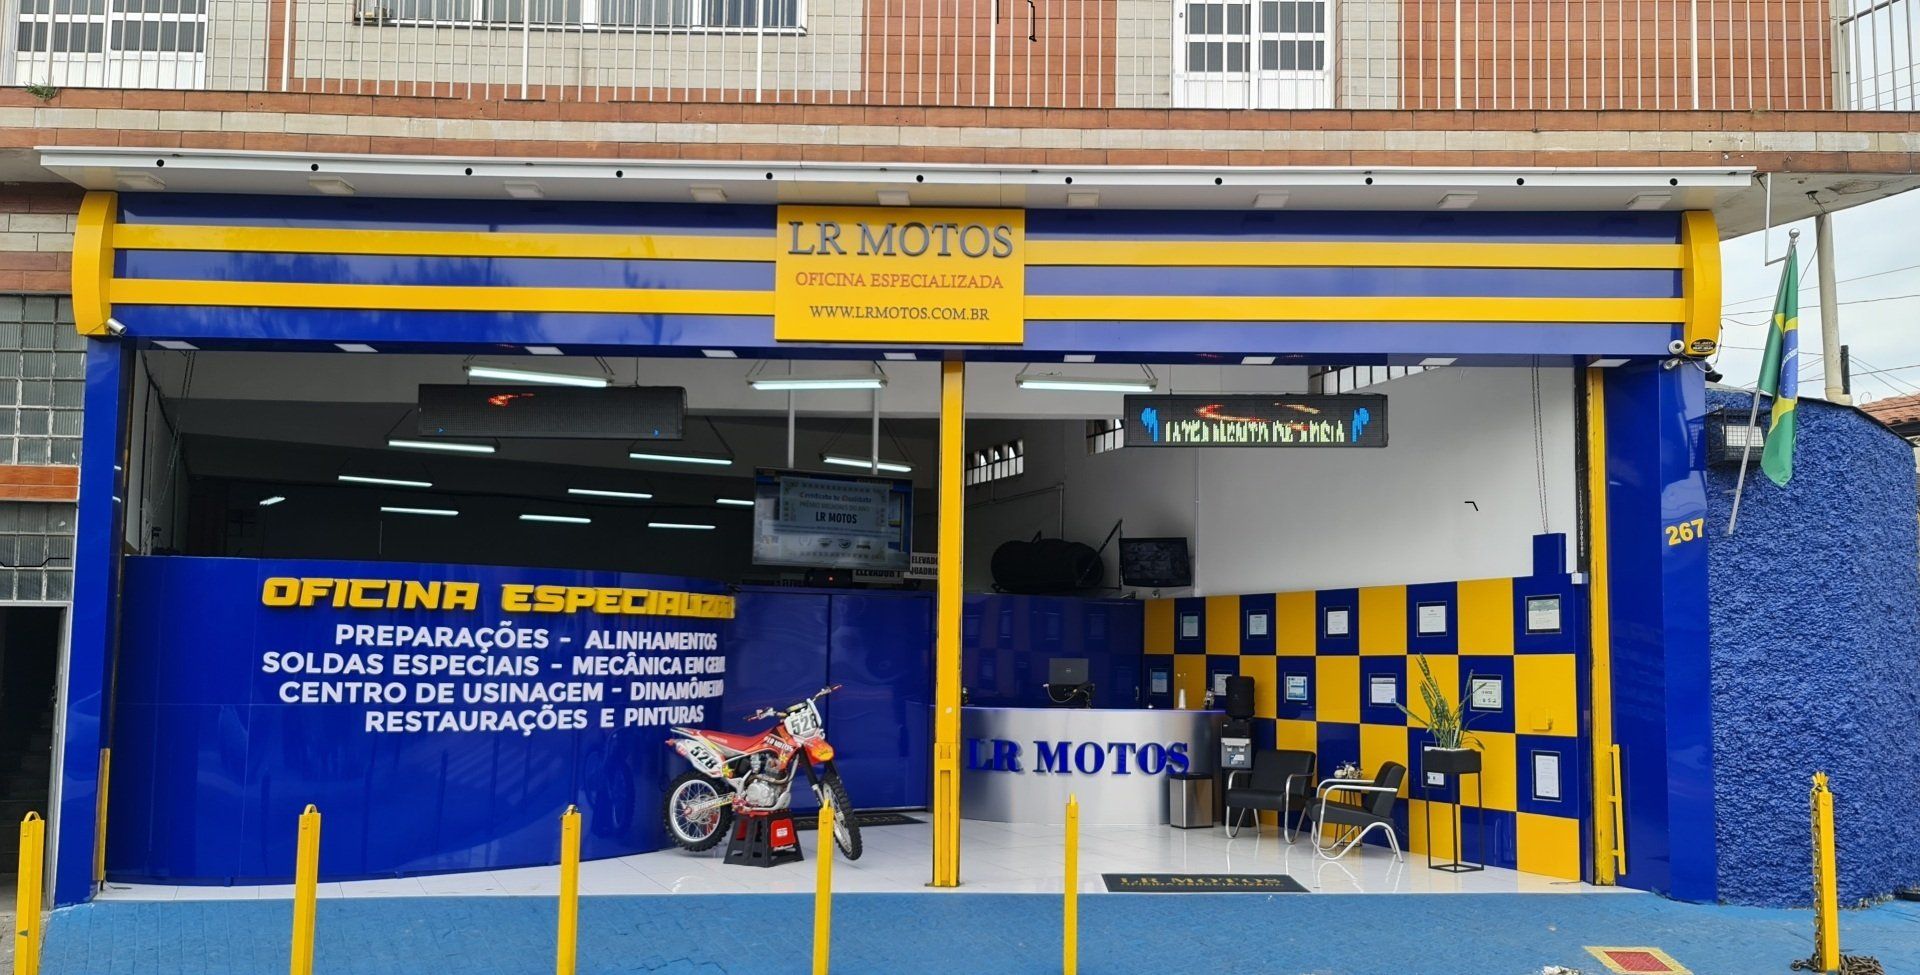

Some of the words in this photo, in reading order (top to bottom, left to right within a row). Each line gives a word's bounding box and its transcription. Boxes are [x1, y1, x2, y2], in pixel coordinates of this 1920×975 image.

[788, 220, 847, 256] LR
[857, 221, 1013, 258] MOTOS
[795, 272, 866, 288] OFICINA
[870, 274, 1004, 290] ESPECIALIZADA
[810, 305, 990, 321] WWW.LRMOTOS.COM.BR
[816, 511, 826, 522] LR
[828, 512, 858, 524] MOTOS
[1665, 518, 1705, 546] 267
[262, 577, 480, 611] OFICINA
[335, 620, 549, 654] PREPARAÇÕES
[584, 630, 718, 650] ALINHAMENTOS
[262, 651, 384, 675] SOLDAS
[393, 653, 540, 676] ESPECIAIS
[572, 652, 682, 676] MECÂNICA
[685, 656, 704, 674] EM
[279, 681, 407, 704] CENTRO
[416, 682, 454, 704] DE
[463, 681, 604, 704] USINAGEM
[365, 704, 588, 737] RESTAURAÇÕES
[601, 708, 615, 728] E
[624, 705, 704, 727] PINTURAS
[791, 713, 818, 735] 528
[690, 745, 718, 770] 528
[966, 738, 1023, 774] LR
[1033, 740, 1190, 776] MOTOS
